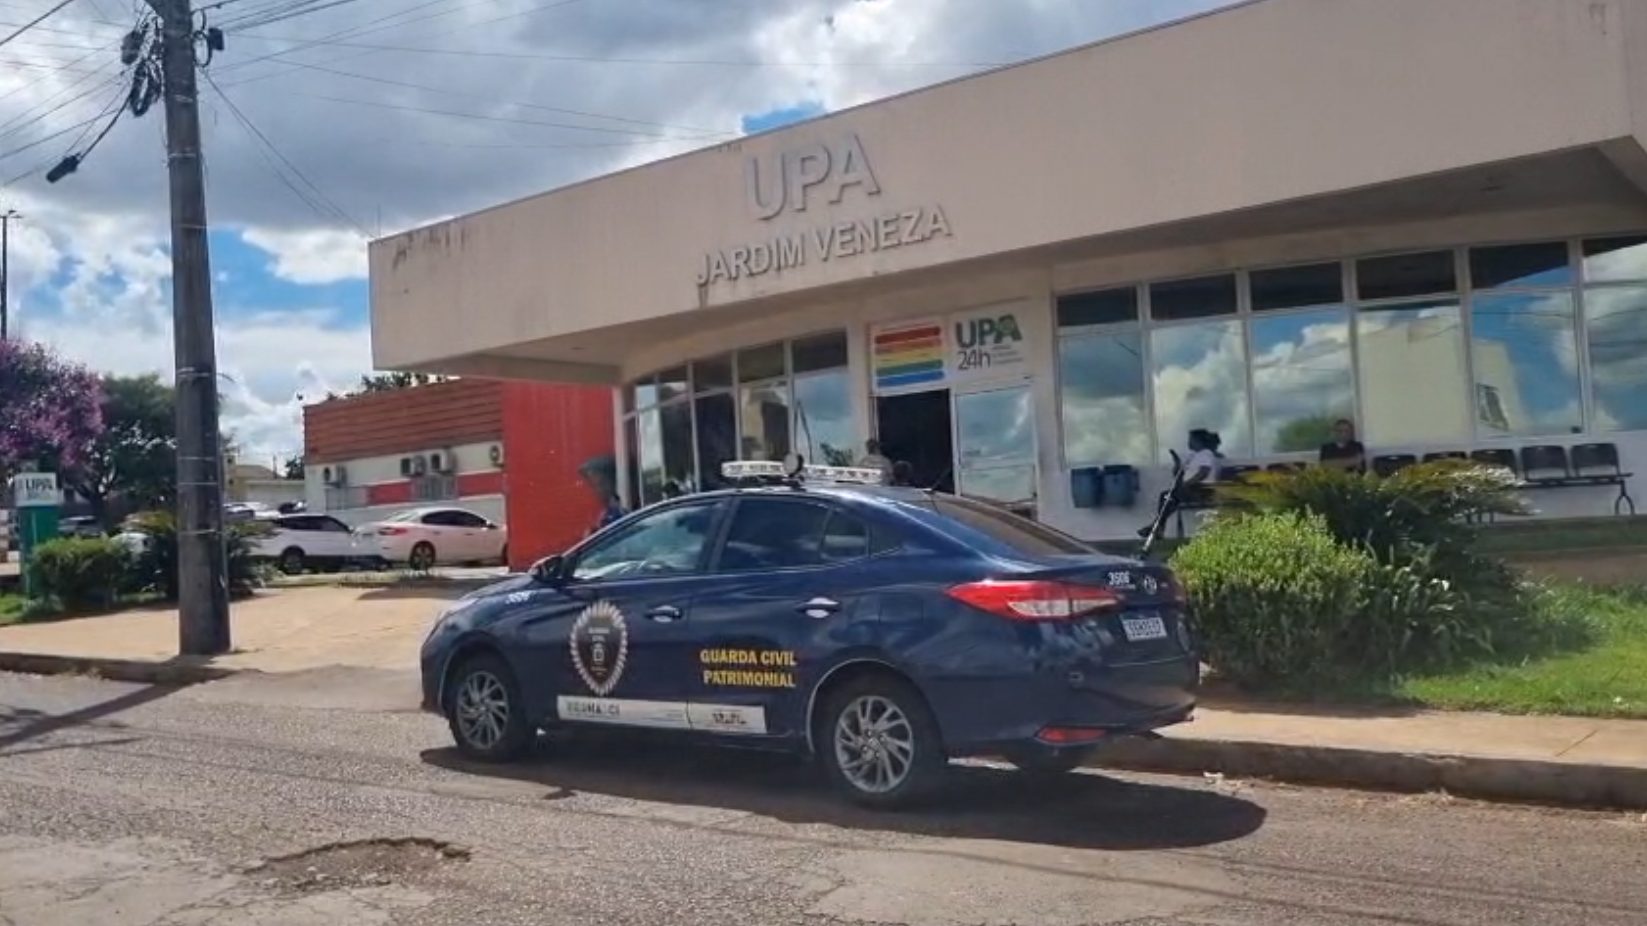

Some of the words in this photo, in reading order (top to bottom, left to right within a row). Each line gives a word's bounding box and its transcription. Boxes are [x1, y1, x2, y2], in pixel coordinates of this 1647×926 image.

[747, 133, 882, 221] UPA
[697, 233, 805, 287] JARDIM
[816, 204, 952, 262] VENEZA
[955, 314, 1022, 349] UPA
[957, 350, 991, 371] 24h
[25, 478, 54, 491] UPA
[700, 649, 757, 665] GUARDA
[760, 651, 797, 666] CIVIL
[703, 670, 796, 688] PATRIMONIAL
